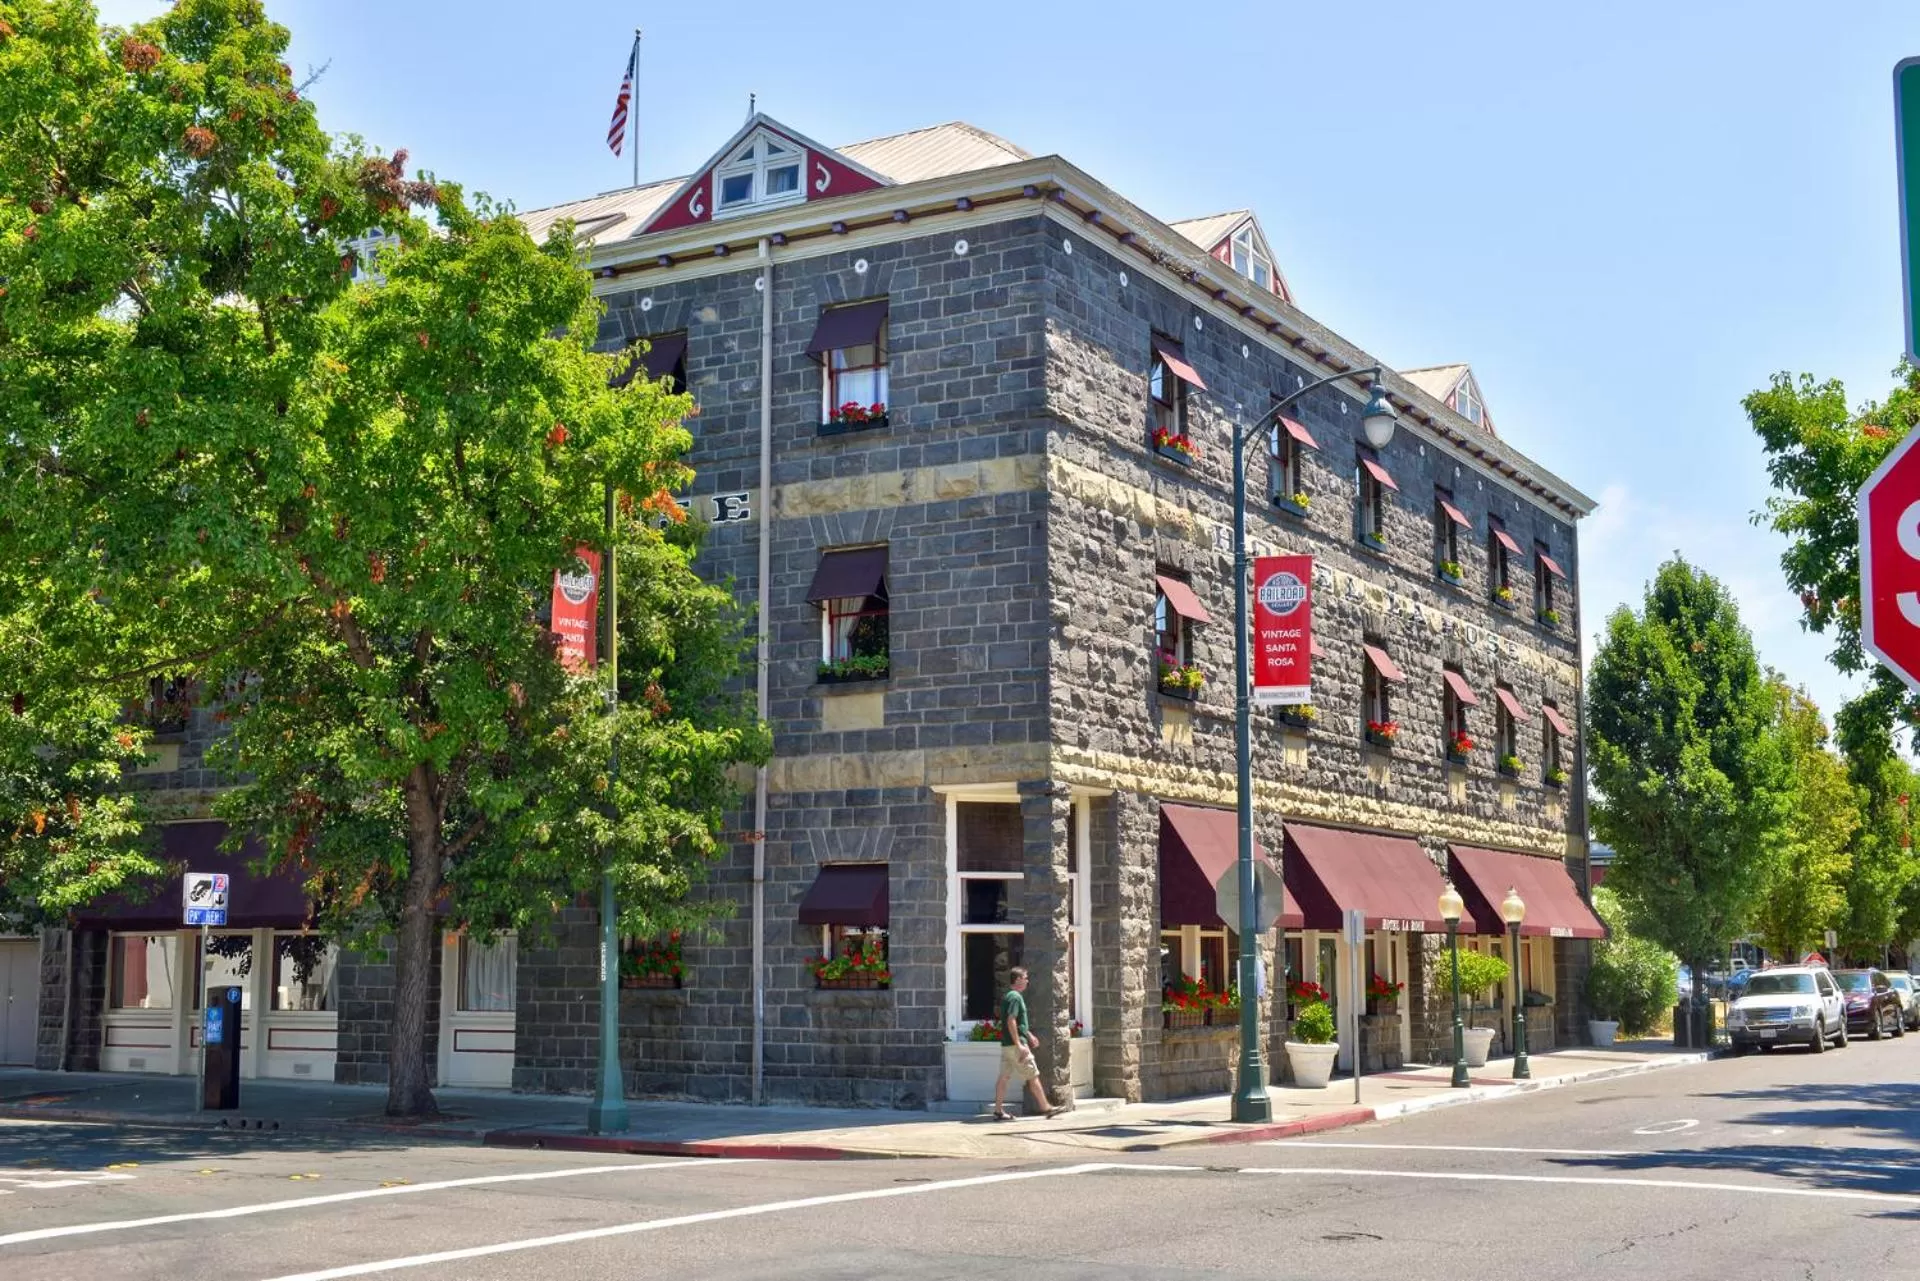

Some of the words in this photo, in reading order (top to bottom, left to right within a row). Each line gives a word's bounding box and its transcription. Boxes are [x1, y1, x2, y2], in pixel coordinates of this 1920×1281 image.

[1260, 587, 1304, 600] RAILROAD
[559, 617, 589, 629] VINTAGE
[1261, 629, 1302, 639] VINTAGE
[1265, 643, 1297, 652] SANTA
[1267, 657, 1295, 667] ROSA
[216, 876, 225, 888] 2
